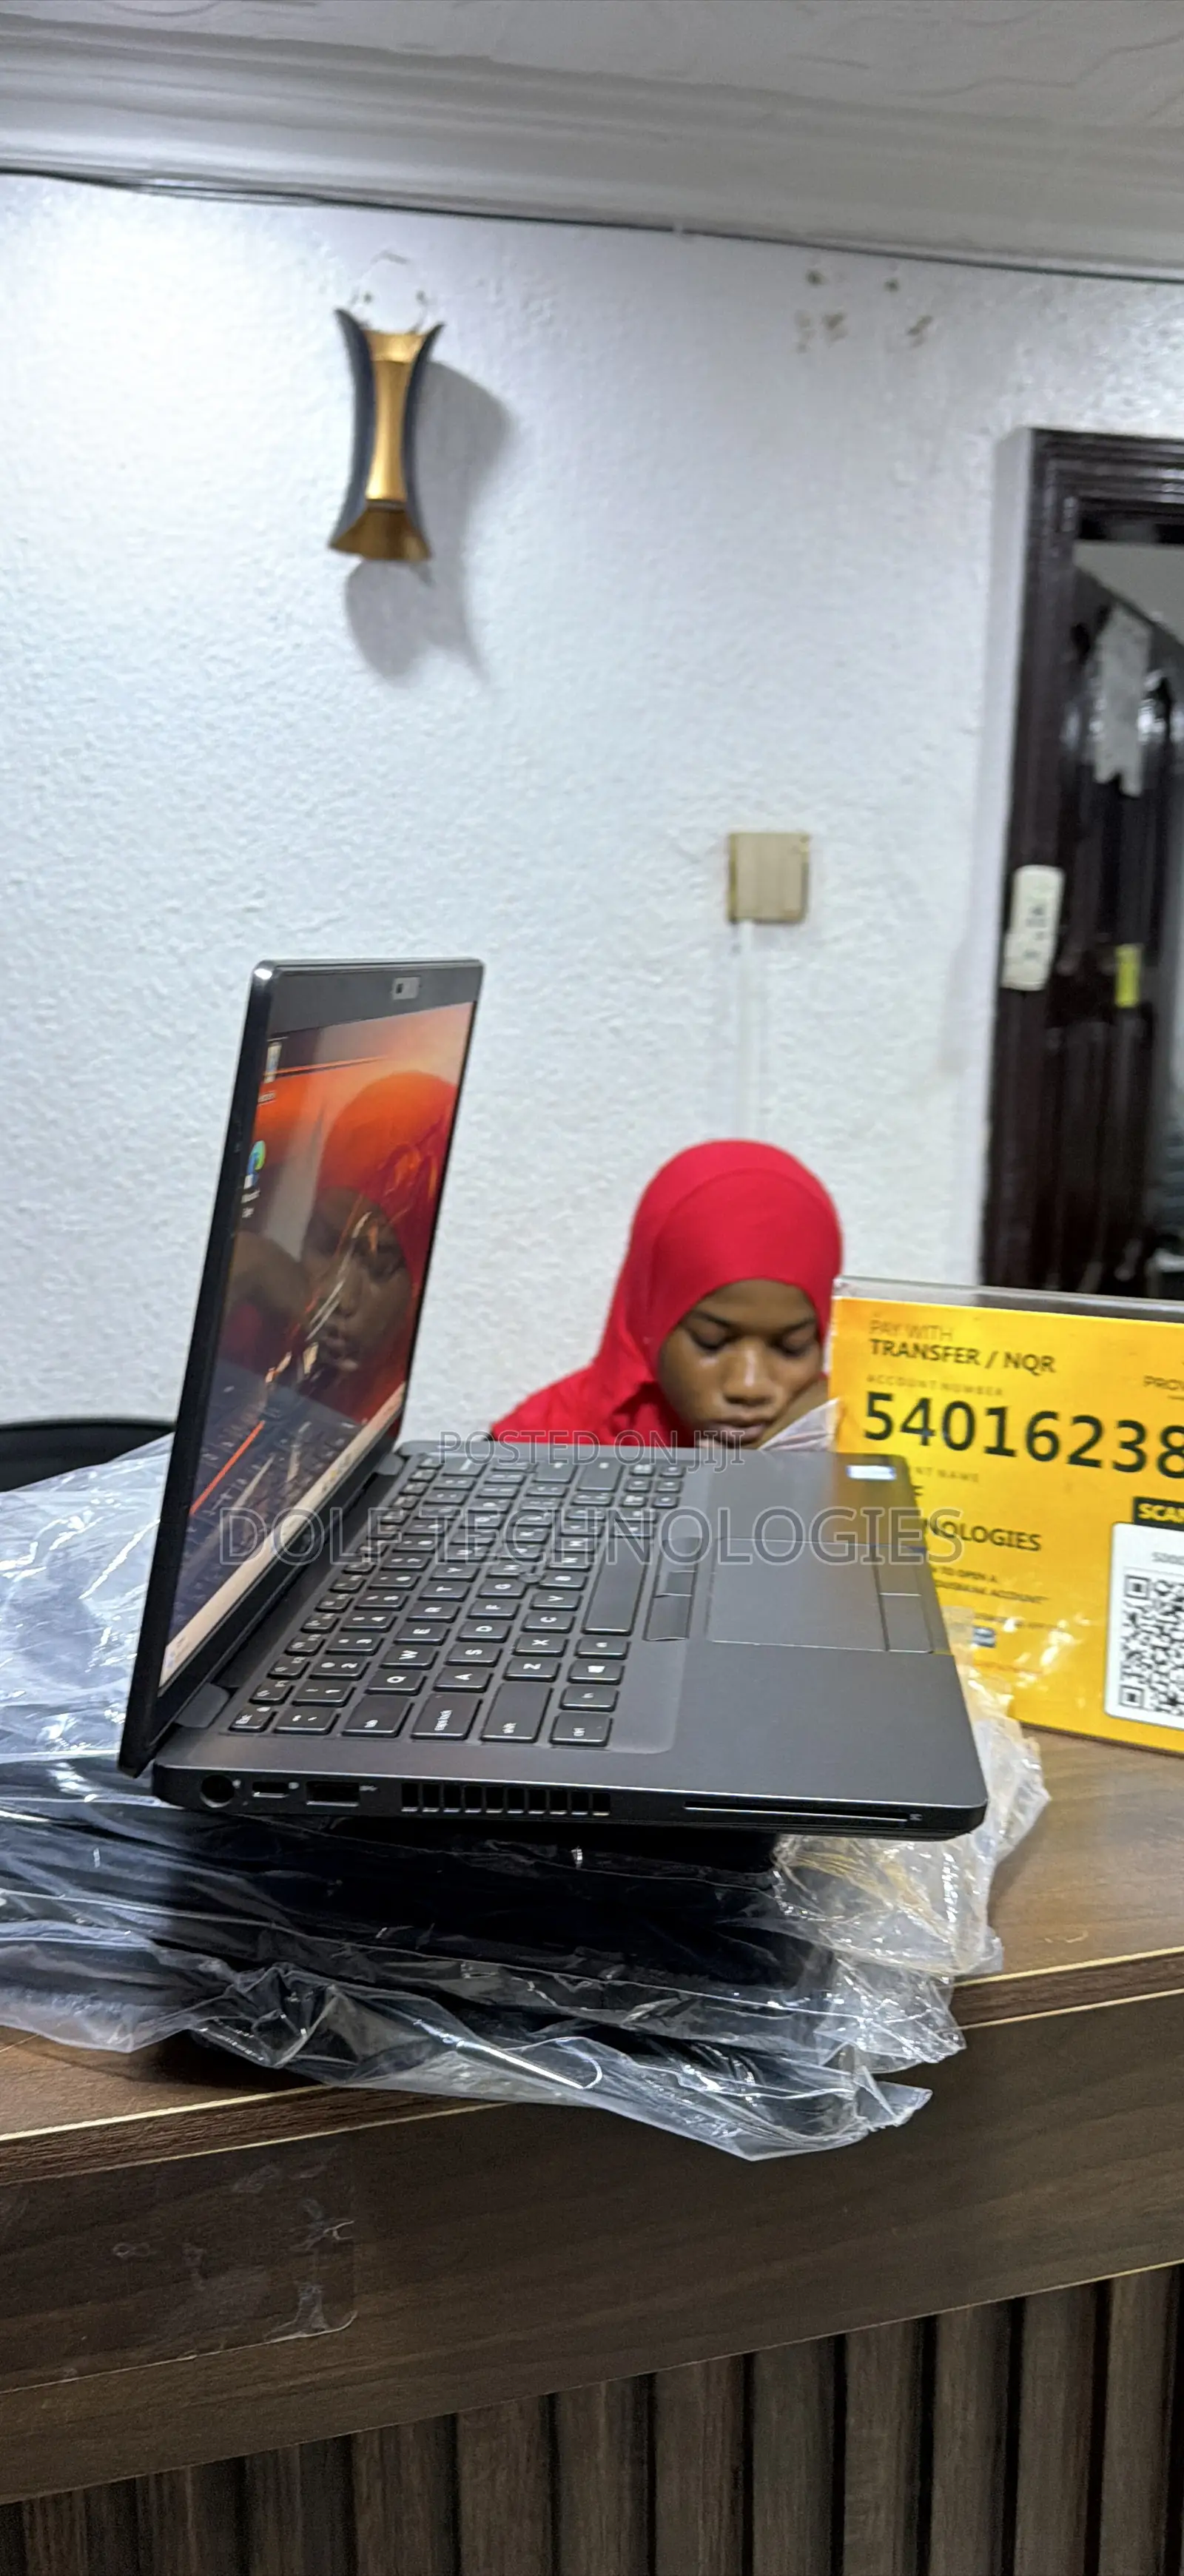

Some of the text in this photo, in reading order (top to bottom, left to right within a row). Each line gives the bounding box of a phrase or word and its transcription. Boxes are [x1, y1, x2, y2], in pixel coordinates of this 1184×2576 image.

[870, 1319, 953, 1342] PAY WITH
[870, 1338, 1057, 1376] TRANSFER / NQR
[867, 1373, 1003, 1397] ACCOUNT NUMBER
[863, 1391, 1184, 1480] 54016238
[922, 1517, 1042, 1552] NOLOGIES
